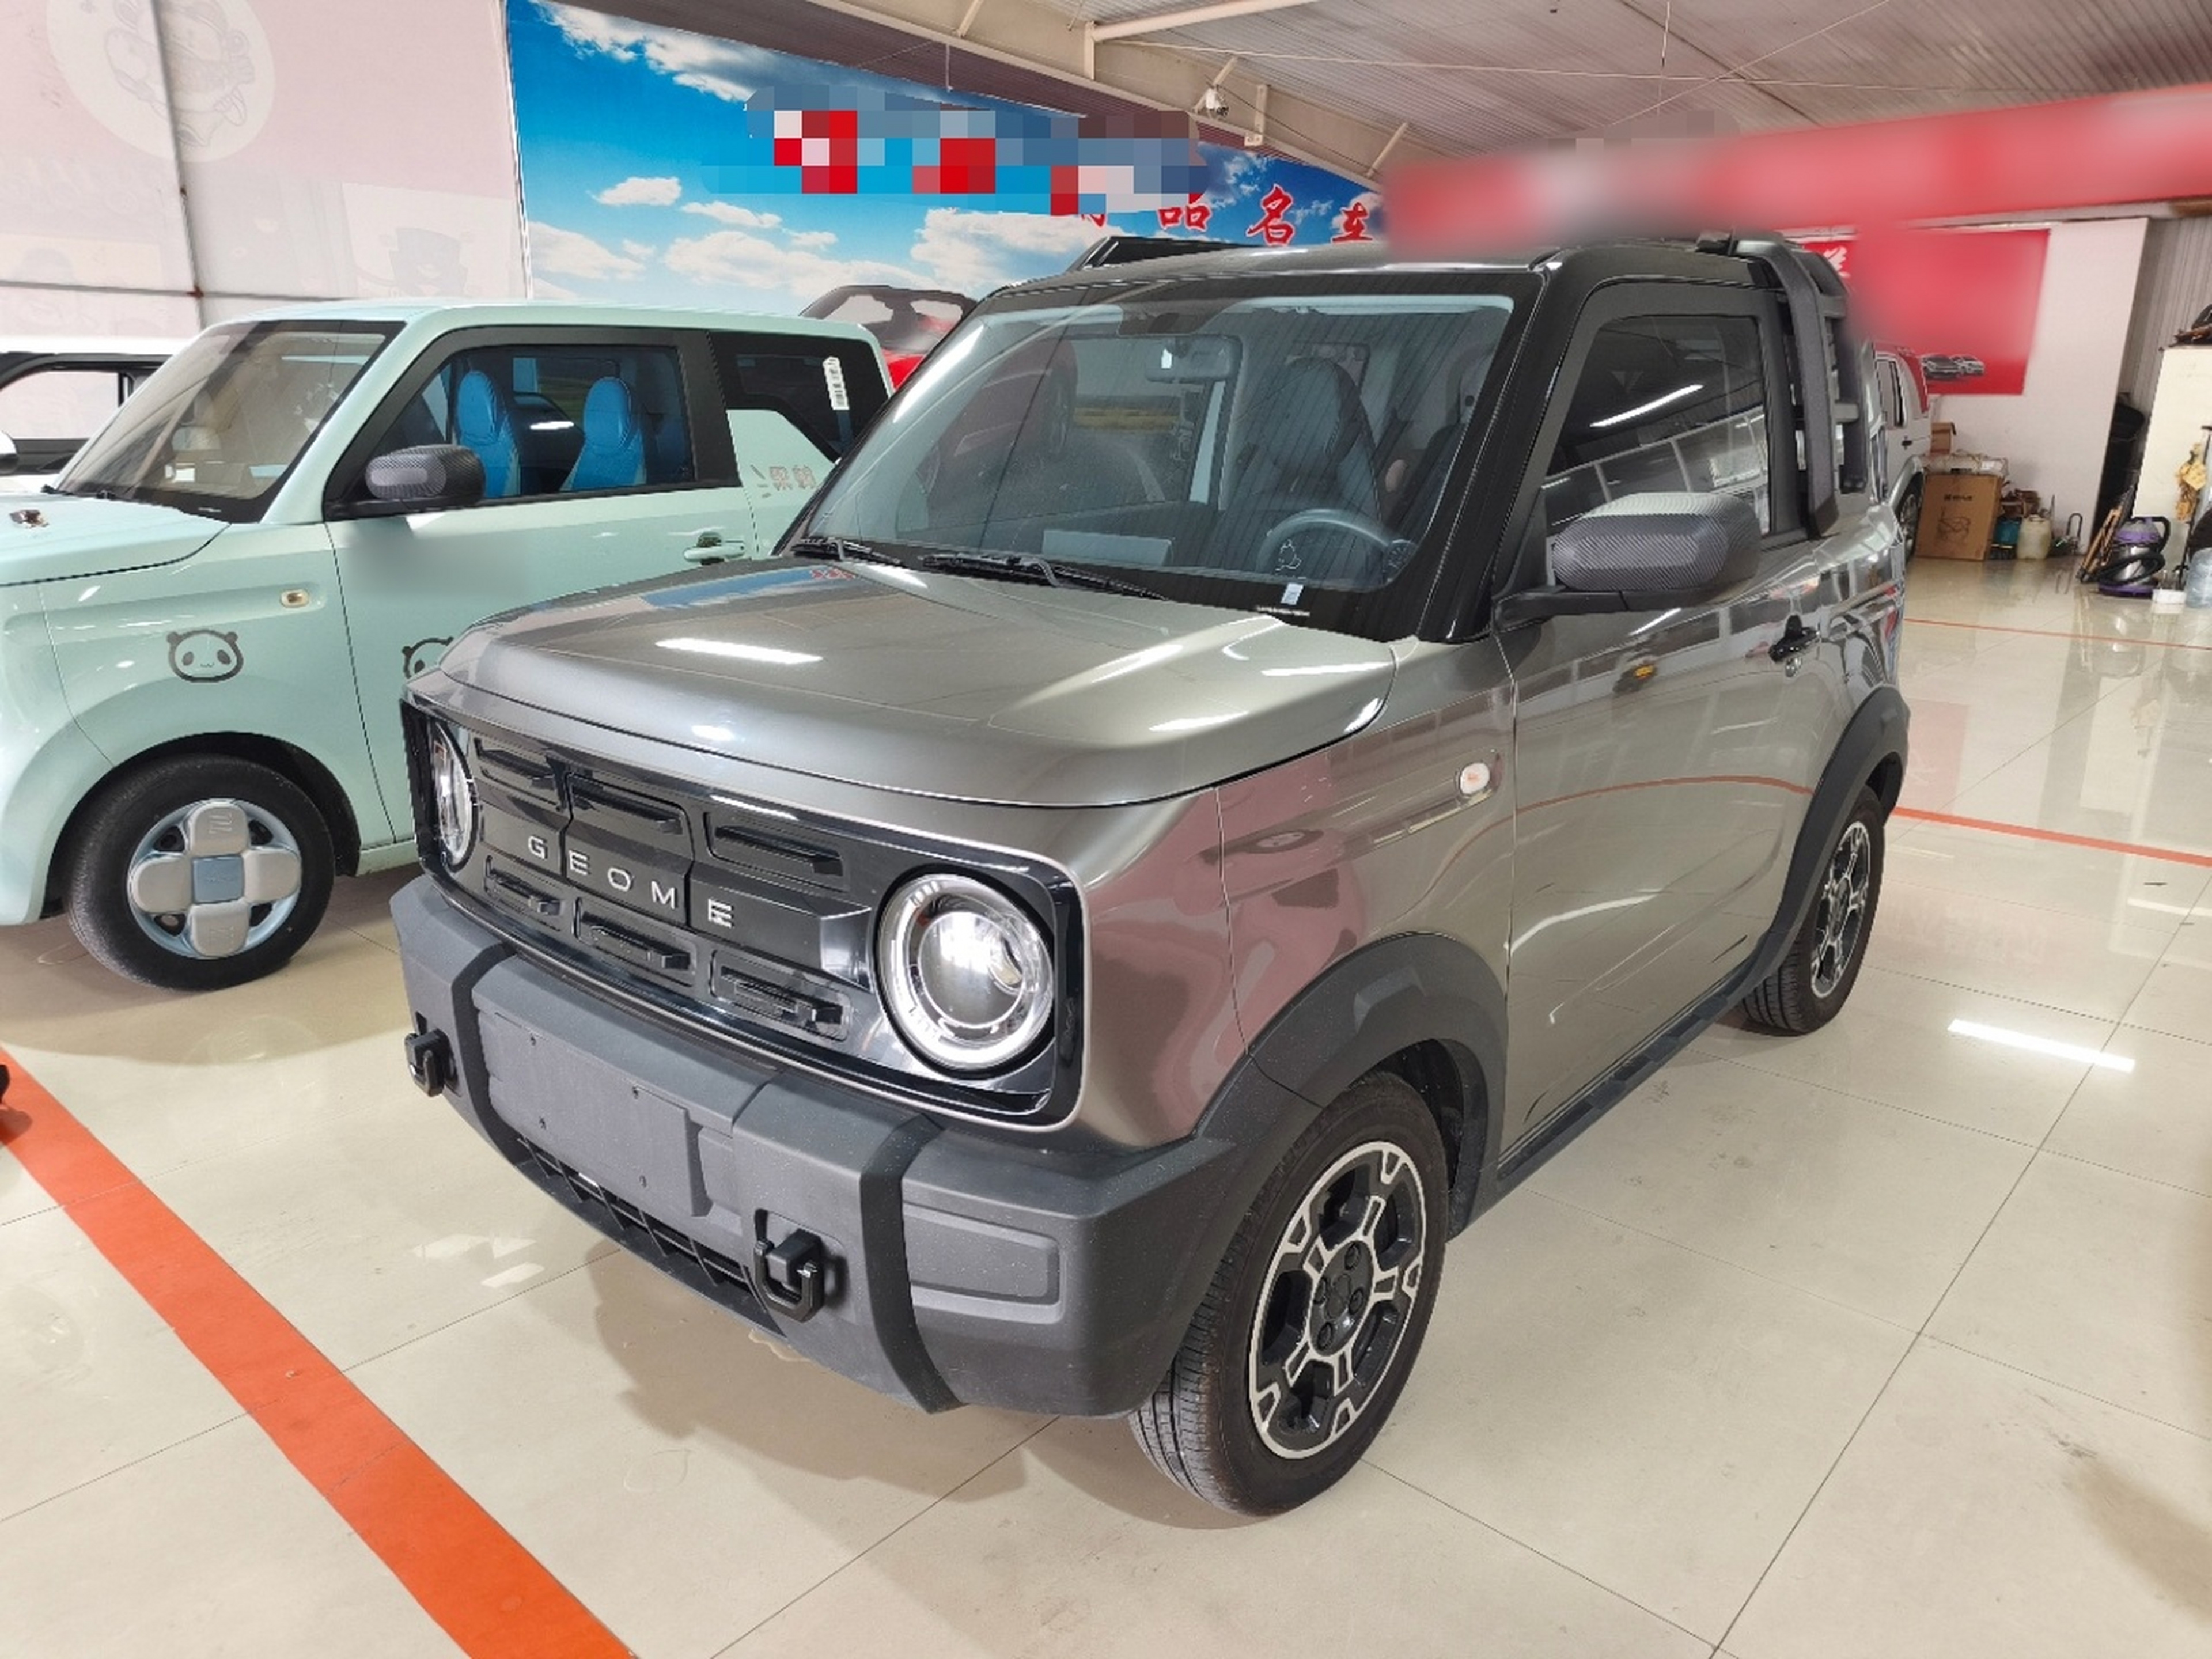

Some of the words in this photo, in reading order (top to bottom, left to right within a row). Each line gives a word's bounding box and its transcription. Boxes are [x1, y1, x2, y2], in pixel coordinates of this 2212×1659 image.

[1081, 183, 1374, 247] 品名车
[527, 835, 734, 929] GEOME
